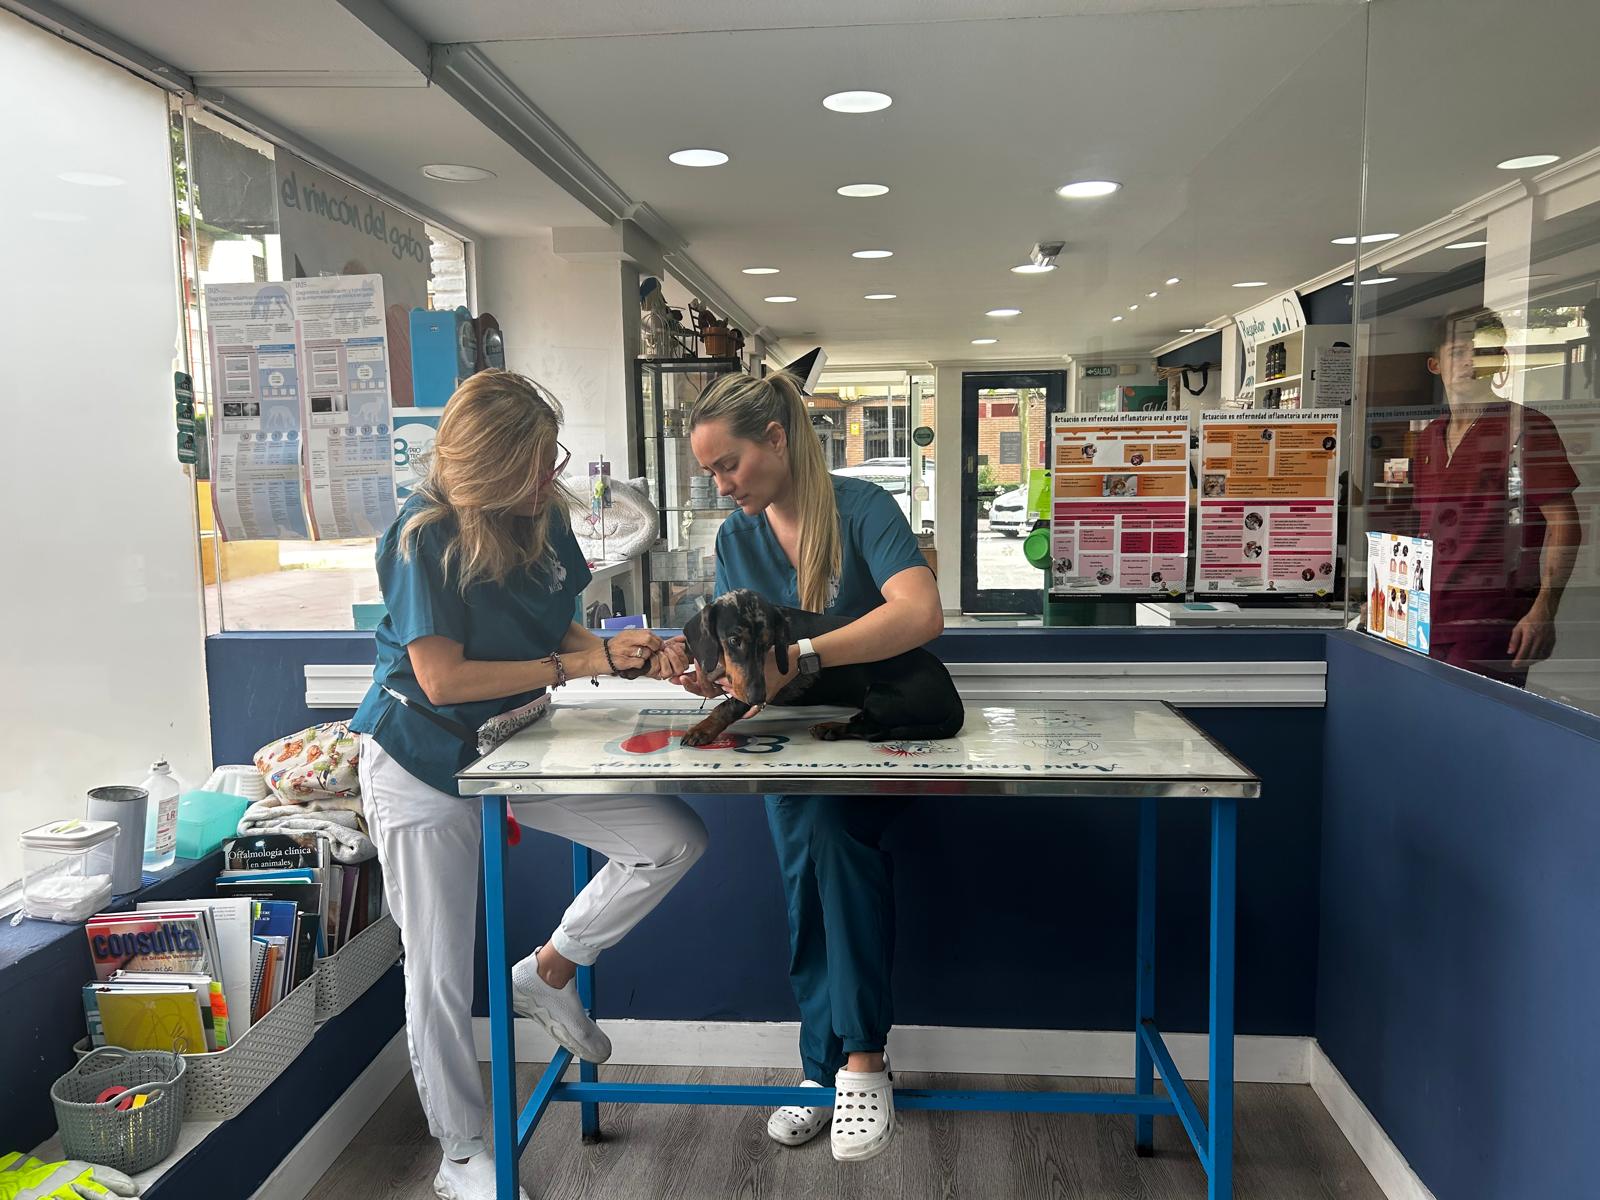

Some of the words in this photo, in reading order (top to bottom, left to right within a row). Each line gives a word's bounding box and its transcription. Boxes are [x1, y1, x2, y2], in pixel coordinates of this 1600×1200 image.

[281, 171, 301, 210] el
[303, 183, 362, 233] rincón
[364, 204, 388, 244] del
[390, 227, 424, 263] gato
[1094, 368, 1111, 376] SALIDA
[1054, 415, 1079, 423] Actuación
[1088, 414, 1119, 422] enfermedad
[1120, 414, 1153, 422] inflamatoria
[1173, 414, 1188, 422] gatos
[1202, 412, 1227, 420] Actuación
[1236, 412, 1267, 420] enfermedad
[648, 708, 712, 716] eresto
[228, 848, 283, 860] Oftalmología
[284, 847, 312, 856] clínica
[261, 860, 291, 868] animales
[93, 923, 201, 959] consulta
